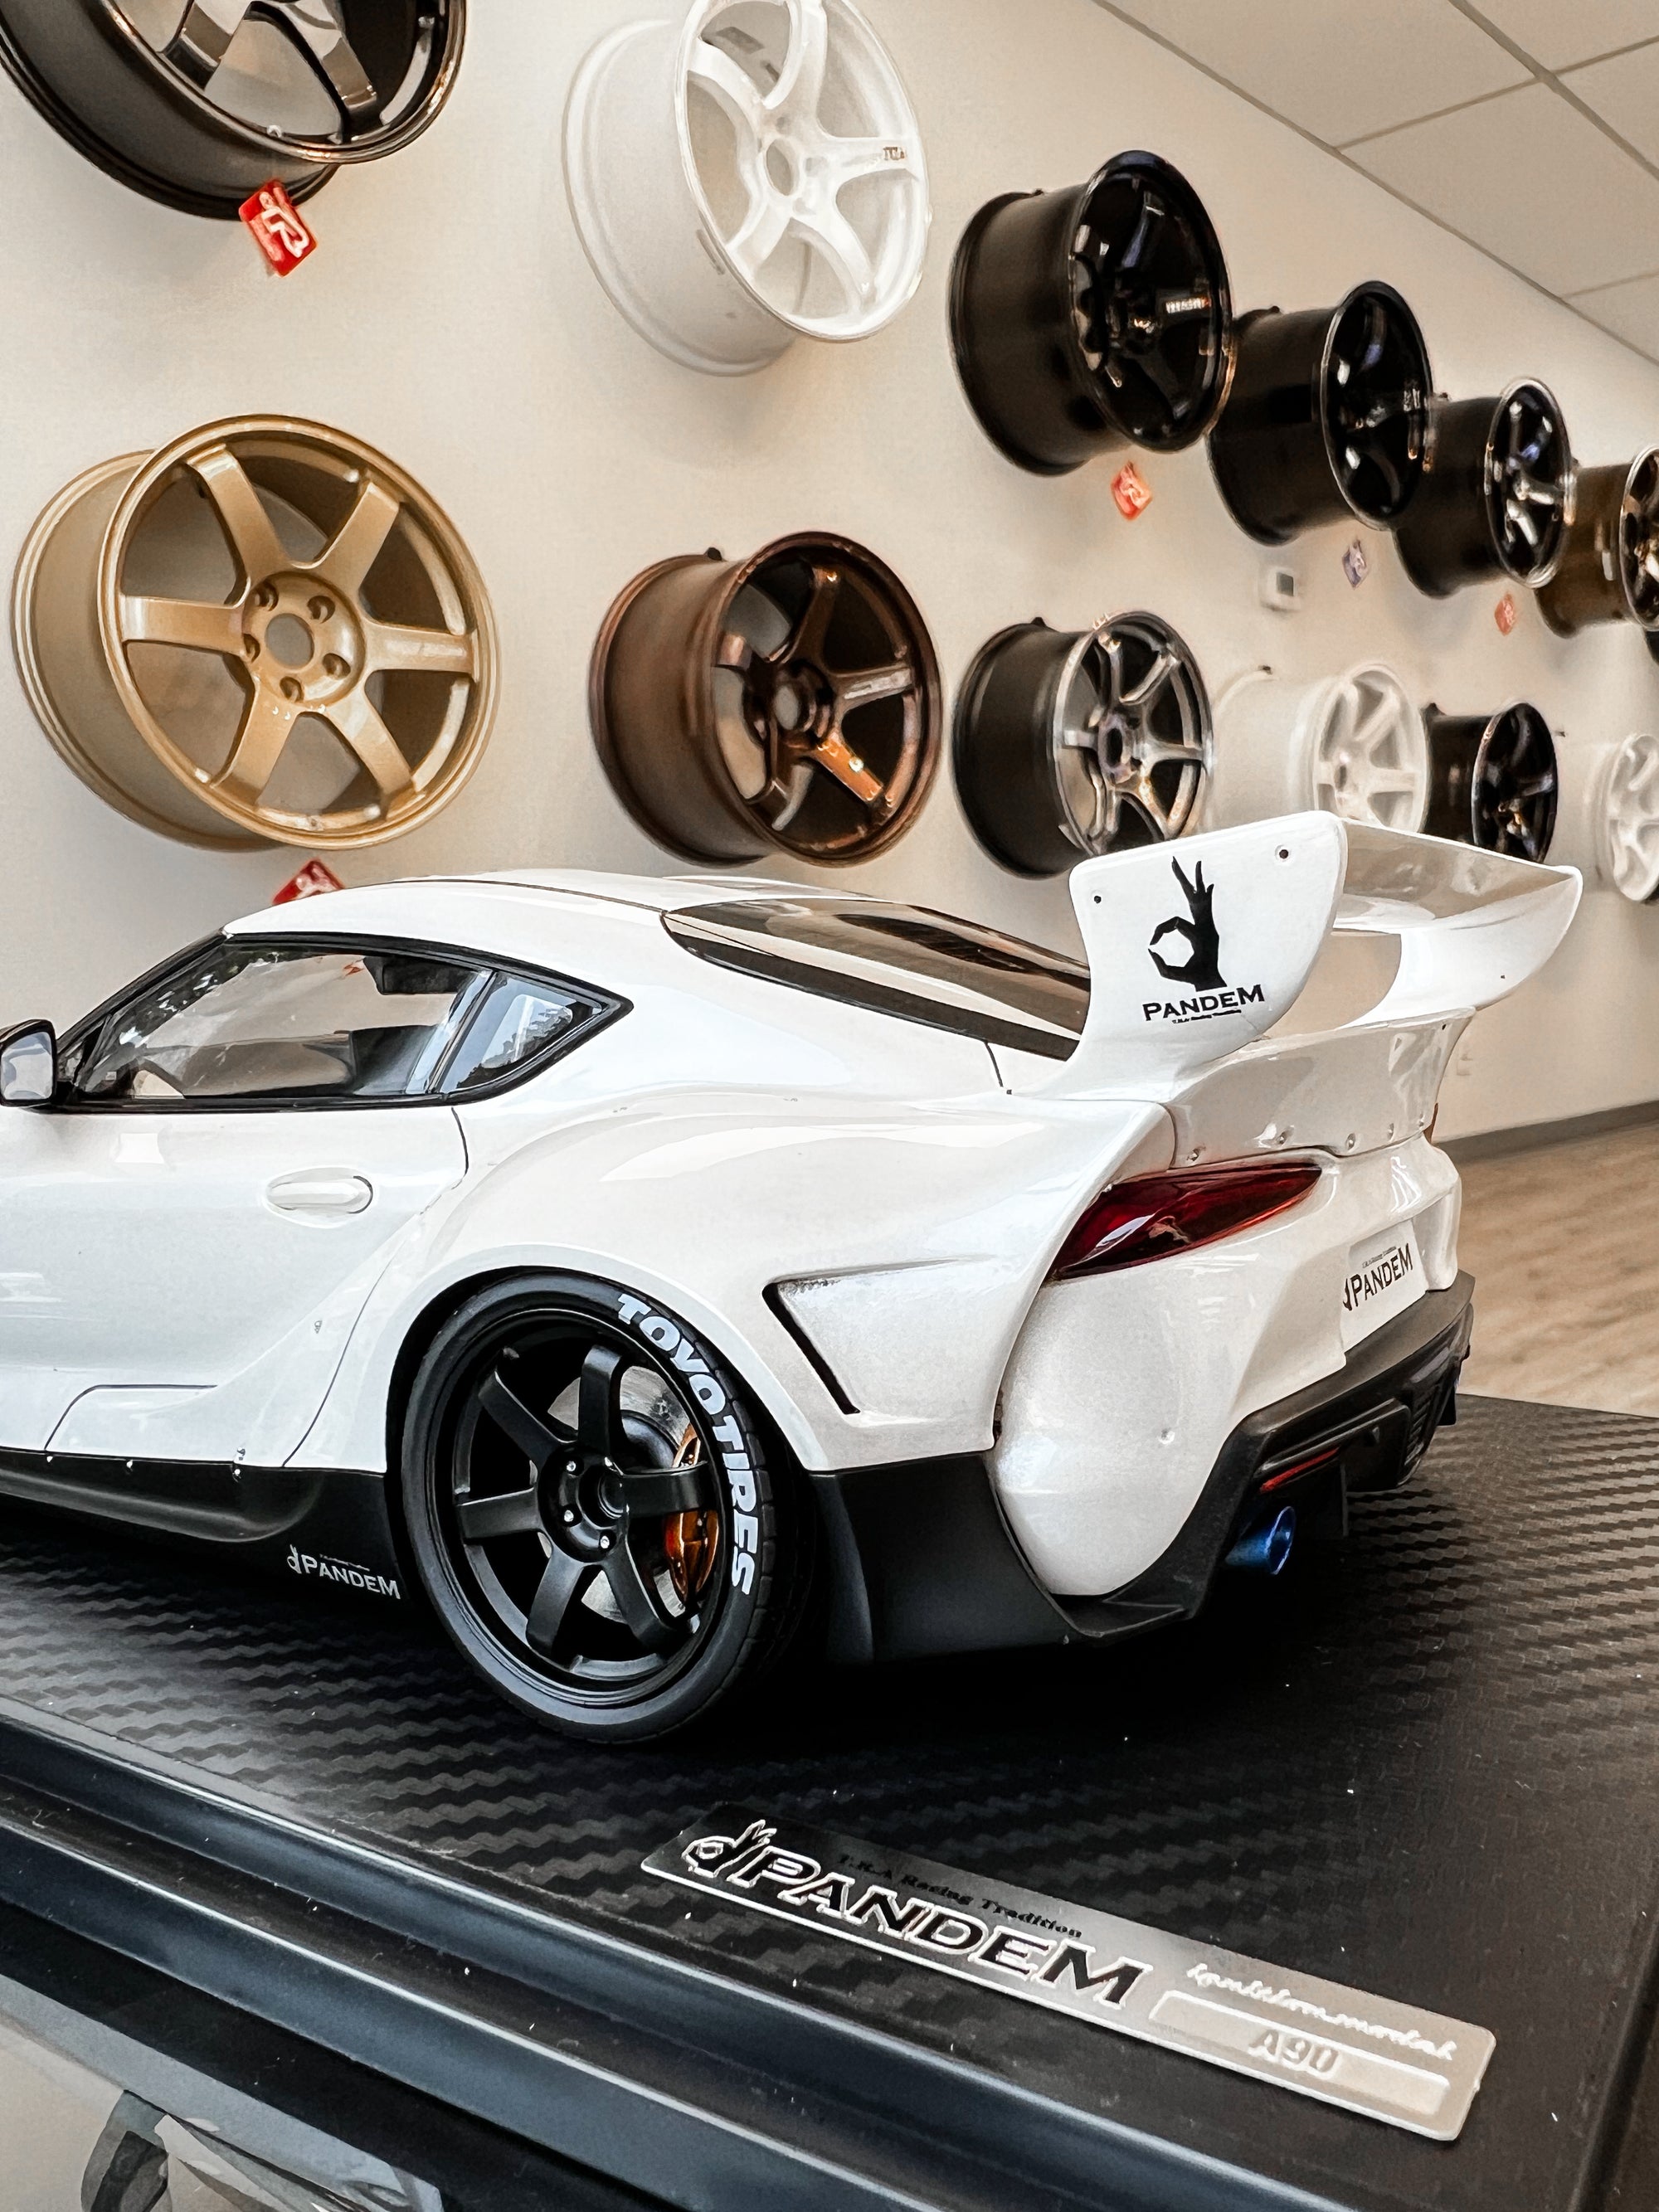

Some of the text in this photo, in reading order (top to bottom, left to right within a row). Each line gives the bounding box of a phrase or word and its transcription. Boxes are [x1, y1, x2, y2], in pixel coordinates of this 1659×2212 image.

[1142, 984, 1265, 1022] PANDEM
[1350, 1242, 1413, 1308] PANDEM
[618, 1293, 760, 1596] TOYO TIRES
[300, 1553, 401, 1601] PANDEM
[725, 1845, 1154, 2010] PANDEM
[980, 1897, 1082, 1939] Tradition
[1247, 2029, 1340, 2075] A90
